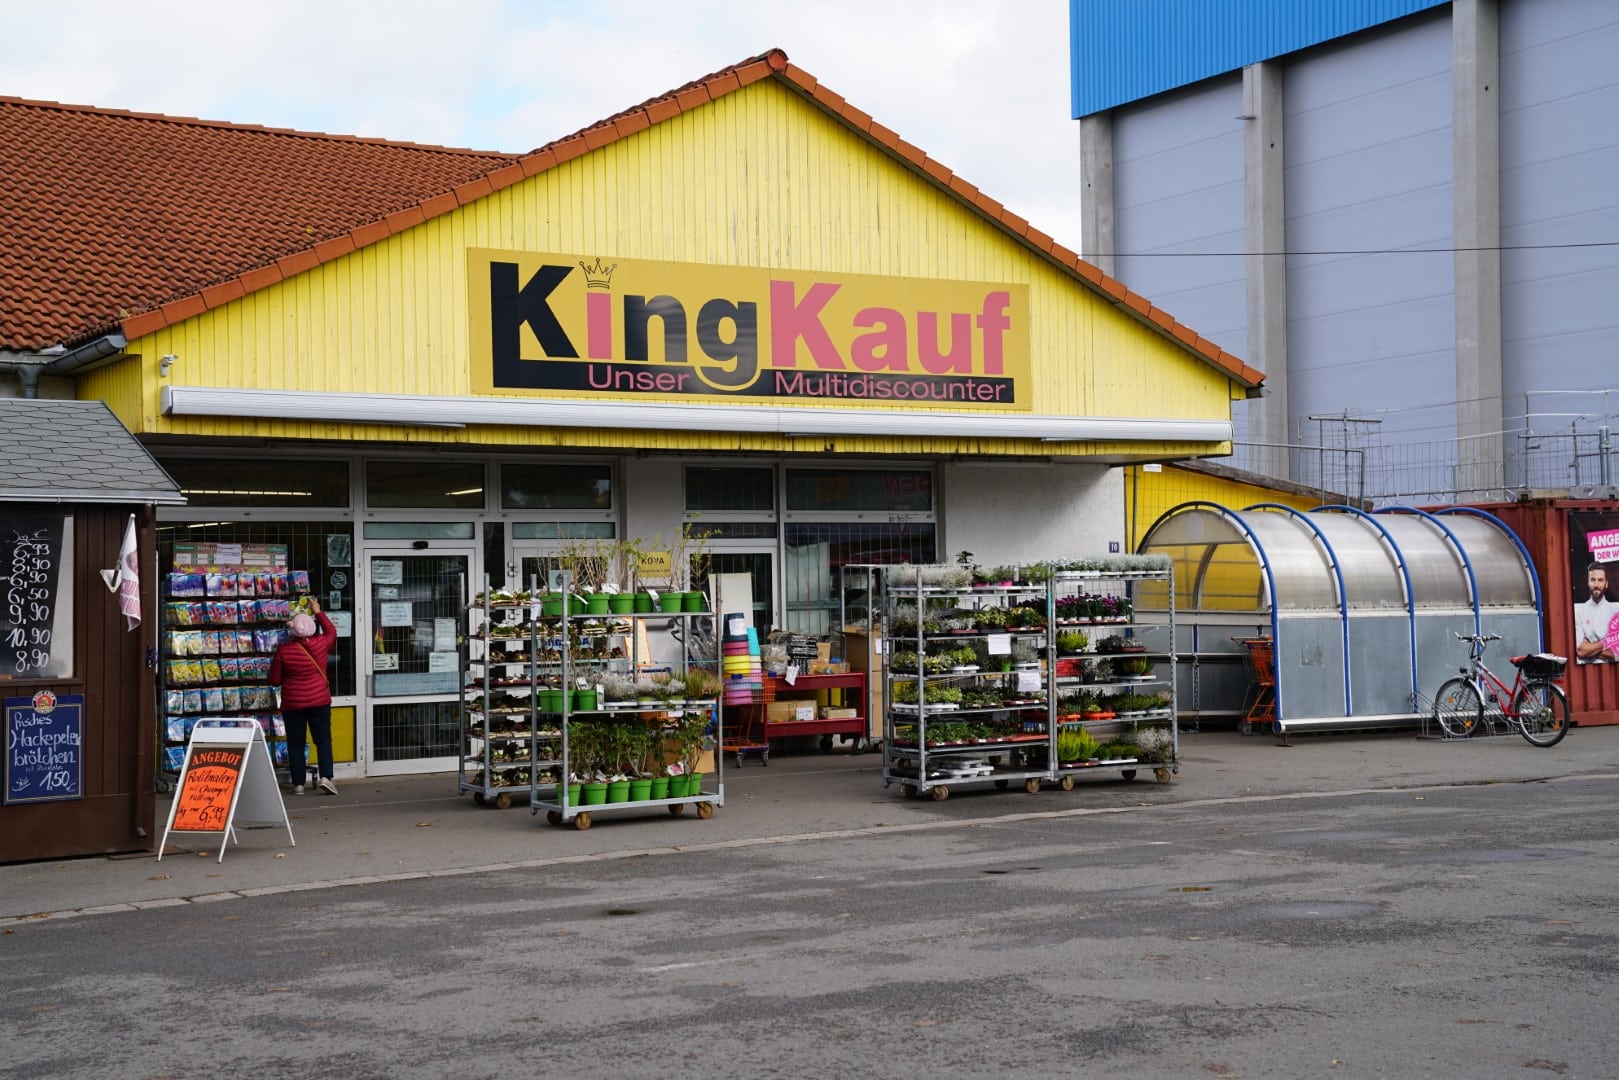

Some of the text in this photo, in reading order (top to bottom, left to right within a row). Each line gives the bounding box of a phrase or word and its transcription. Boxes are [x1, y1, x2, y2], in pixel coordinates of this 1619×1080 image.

[588, 364, 1007, 401] Unser Multidiscounter
[1597, 551, 1611, 560] DER
[12, 557, 51, 575] 8,90
[10, 570, 48, 588] 6,90
[7, 586, 49, 605] 6,50
[9, 602, 50, 625] 9,90
[5, 628, 51, 648] 10,90
[16, 648, 50, 672] 8,90
[192, 752, 241, 766] ANGEBOT
[39, 770, 70, 791] 1,50
